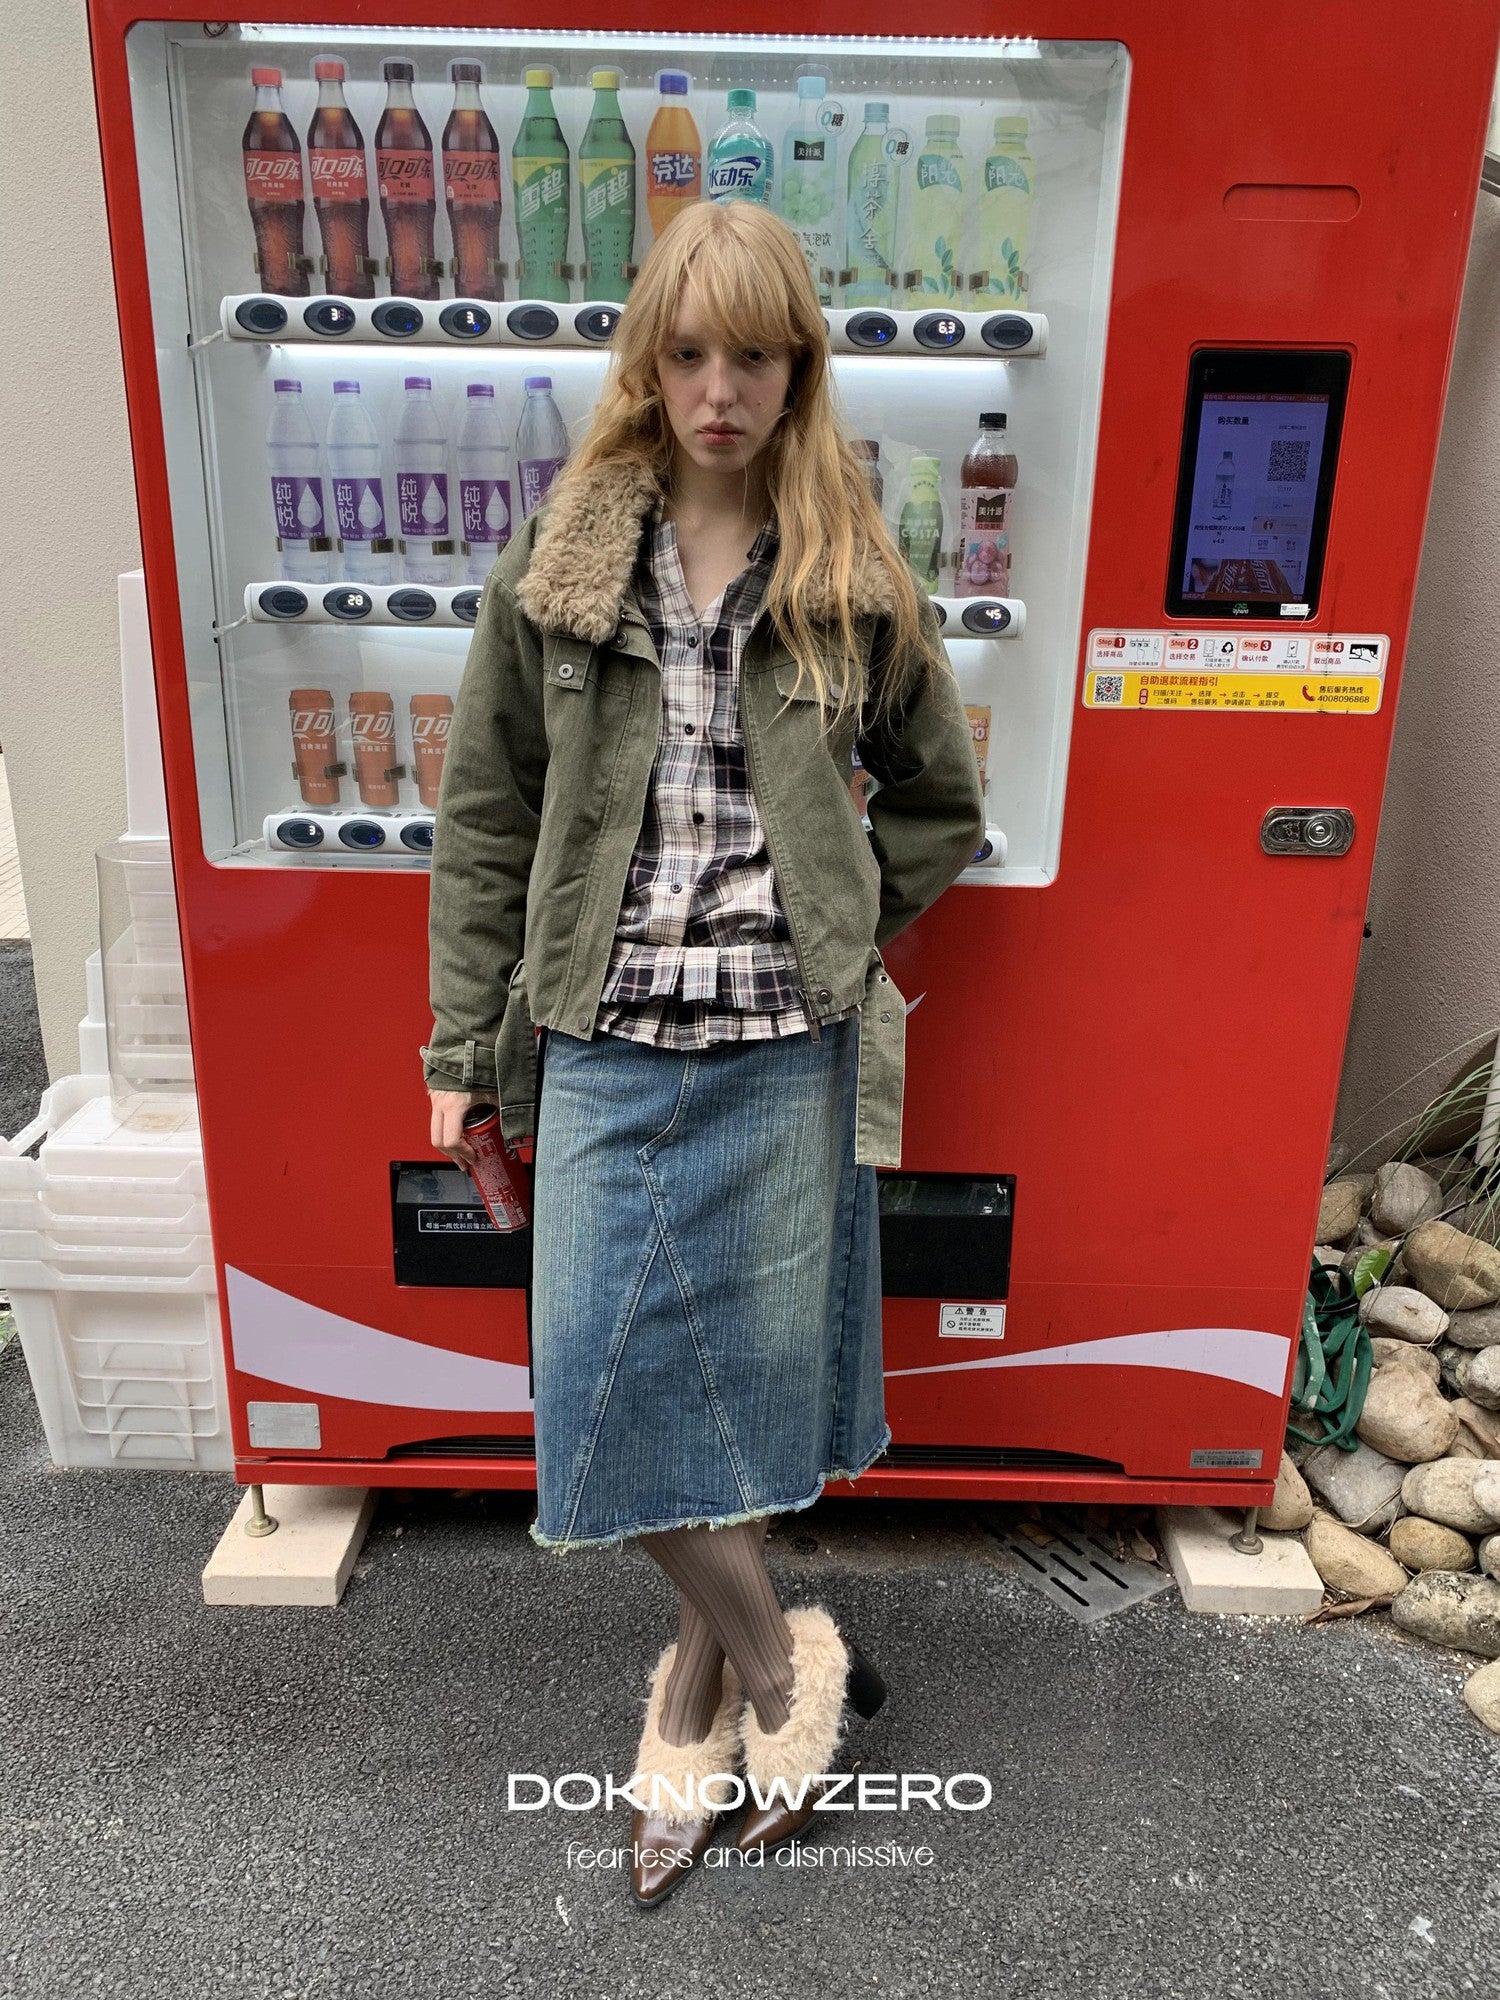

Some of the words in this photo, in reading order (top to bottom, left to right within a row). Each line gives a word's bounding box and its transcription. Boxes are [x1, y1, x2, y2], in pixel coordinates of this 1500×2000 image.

[246, 158, 301, 181] 可口可乐
[311, 155, 365, 180] 可口可乐
[379, 156, 432, 180] 可口可乐
[445, 158, 498, 182] 可口可乐
[652, 153, 695, 183] 芬达
[520, 168, 566, 219] 雪碧
[585, 169, 632, 220] 雪碧
[1218, 416, 1249, 426] 购买数量
[276, 482, 294, 528] 纯悦
[337, 484, 355, 529] 纯悦
[401, 478, 419, 524] 纯悦
[464, 485, 482, 531] 纯悦
[901, 528, 940, 539] COSTA
[1098, 638, 1113, 647] Step
[1170, 639, 1185, 648] Step
[1243, 641, 1258, 649] Step
[1262, 641, 1269, 650] 3
[1316, 643, 1331, 651] Step
[1334, 643, 1342, 652] 4
[1096, 651, 1123, 659] 选择商品
[1169, 653, 1196, 661] 选择交易
[1313, 657, 1342, 665] 取出商品
[1140, 675, 1218, 687] 自助退款流程指引
[1319, 685, 1364, 694] 售后服务热线
[1191, 698, 1218, 706] 售后服务
[966, 1306, 988, 1316] 警告
